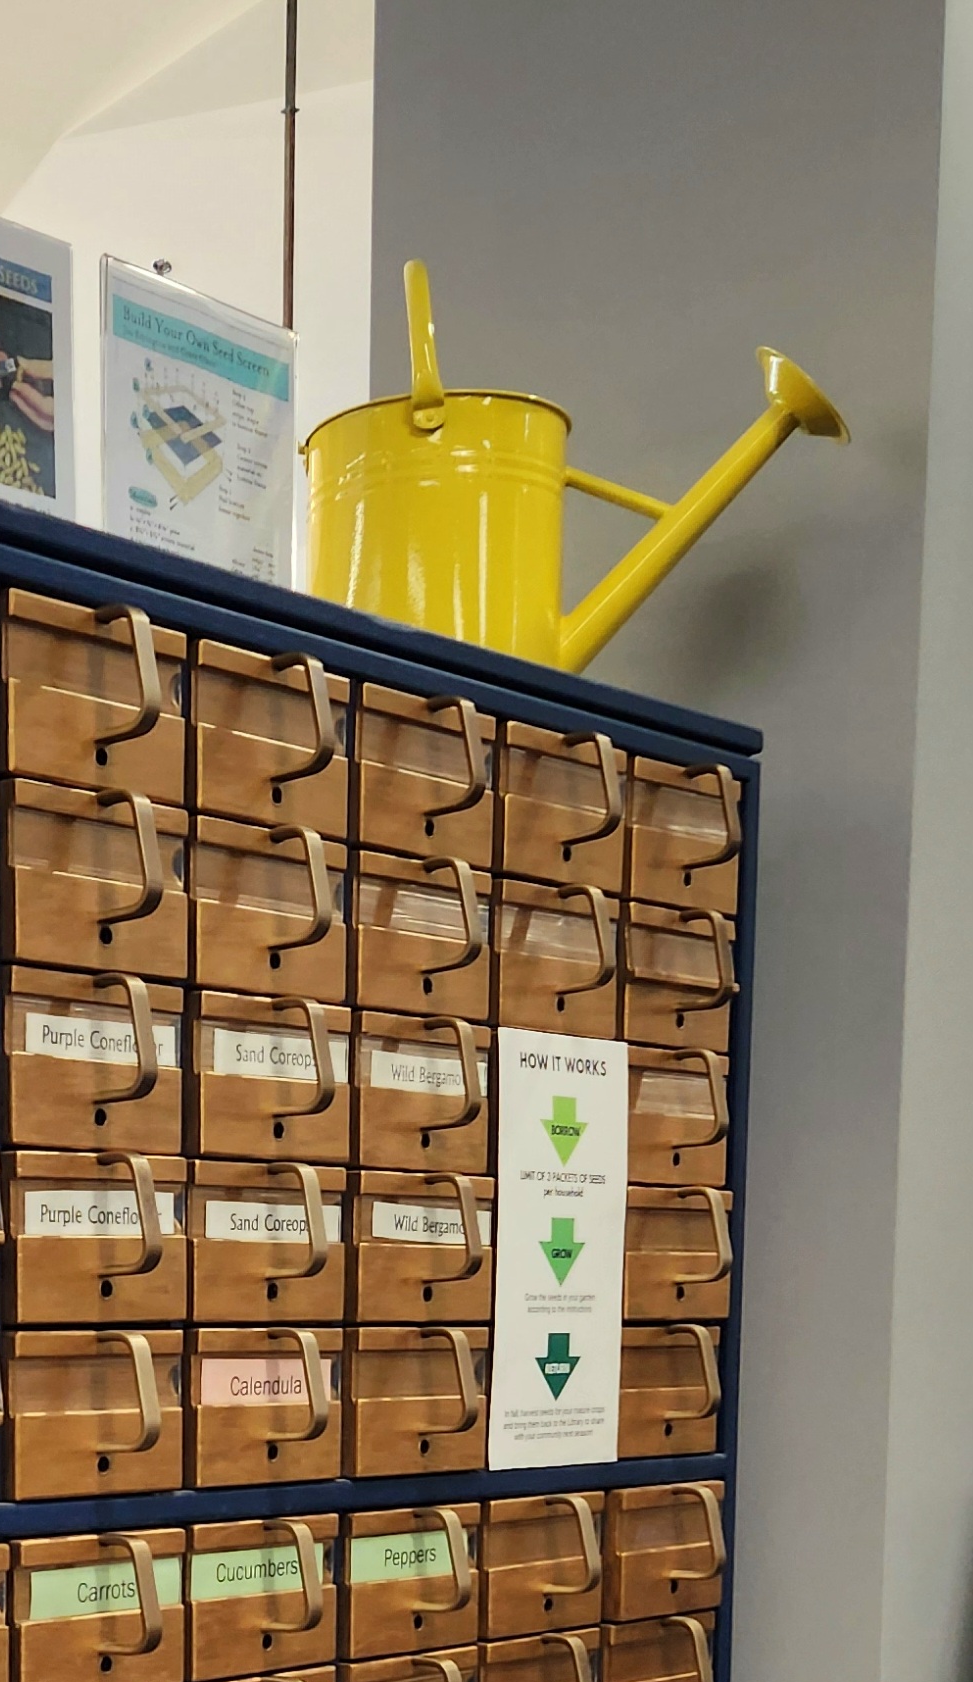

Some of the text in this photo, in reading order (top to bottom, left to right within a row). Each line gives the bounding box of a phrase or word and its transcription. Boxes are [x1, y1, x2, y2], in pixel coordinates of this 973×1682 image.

[123, 305, 152, 330] Build
[154, 315, 182, 341] Your
[186, 330, 210, 352] Own
[212, 340, 234, 363] Seed
[237, 352, 270, 377] Screen
[42, 1024, 85, 1051] Purple
[235, 1043, 315, 1070] Sand Coreop
[519, 1052, 607, 1076] HOW IT WORKS
[391, 1063, 415, 1082] Wild
[419, 1066, 462, 1087] Bergamo
[551, 1124, 582, 1136] BORROW
[40, 1204, 82, 1227] Purple
[230, 1213, 310, 1235] Sand Coreop
[394, 1214, 465, 1237] Wild Bergamo
[552, 1248, 572, 1259] GROW
[230, 1375, 302, 1396] Calendula
[384, 1547, 437, 1570] Peppers
[216, 1558, 299, 1583] Cucumbers
[77, 1579, 136, 1604] Carrots
